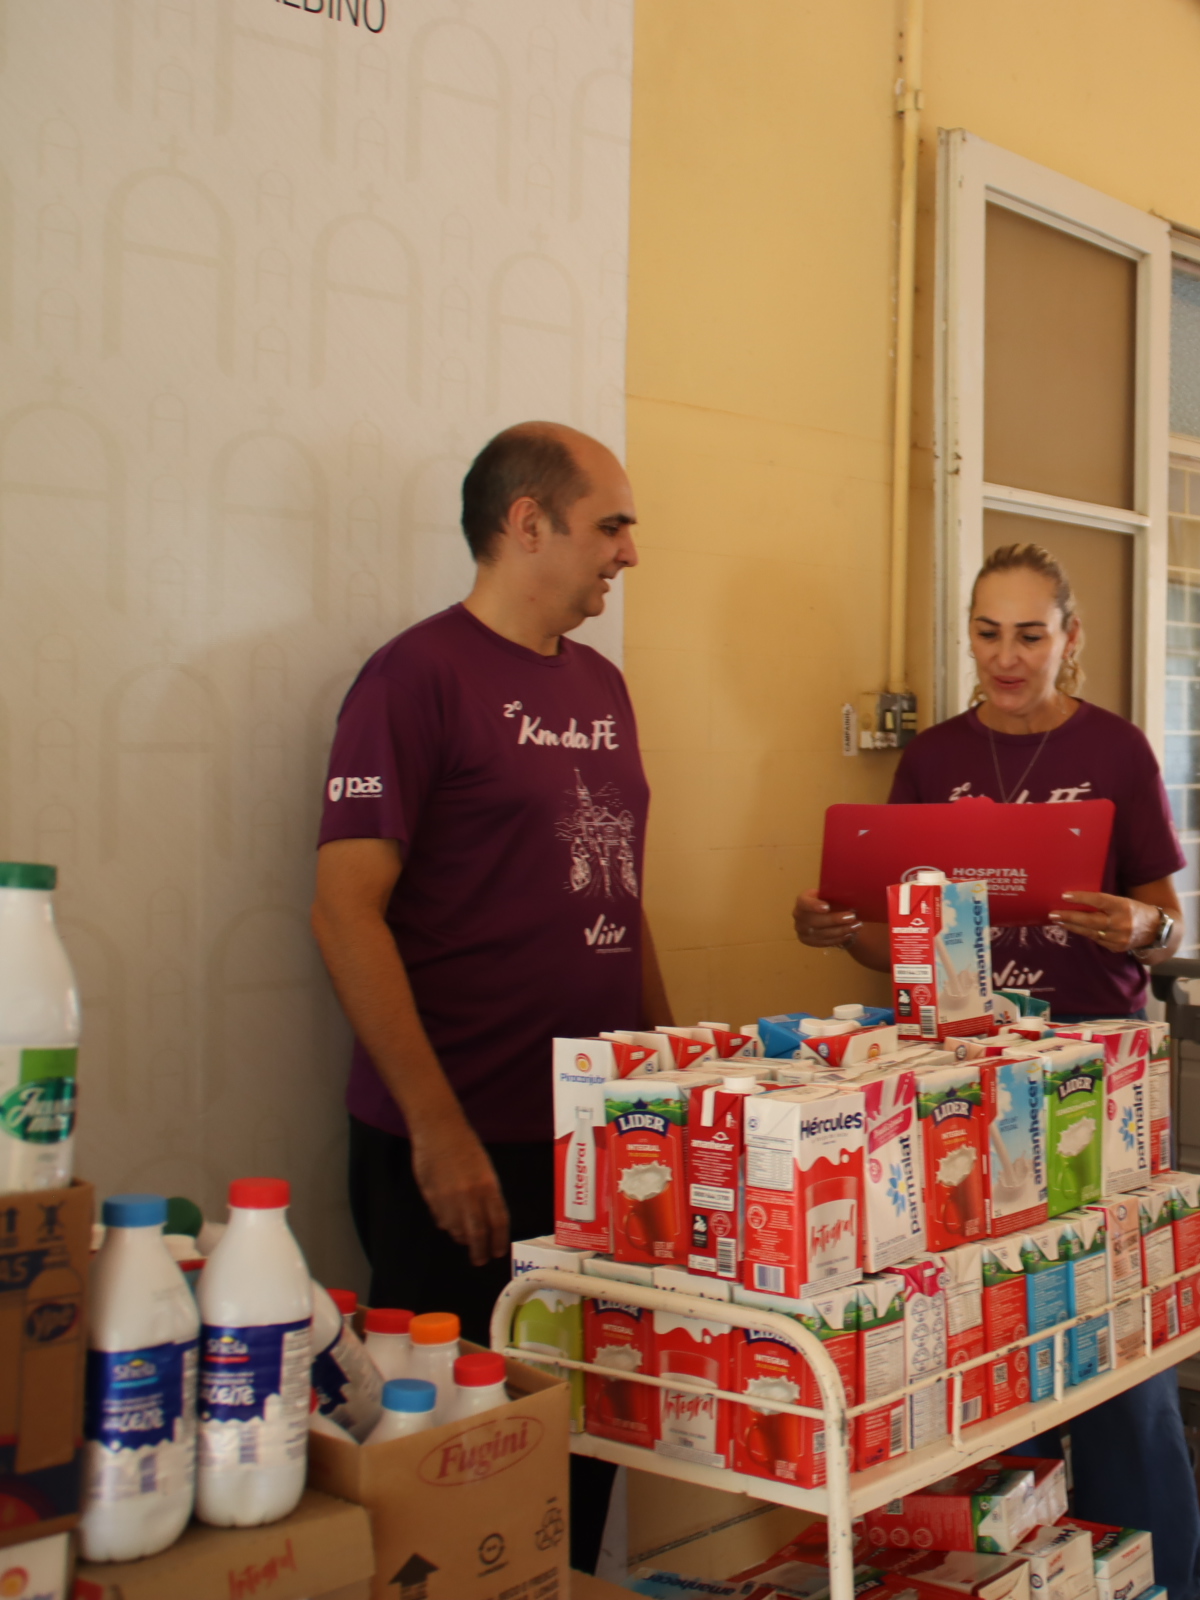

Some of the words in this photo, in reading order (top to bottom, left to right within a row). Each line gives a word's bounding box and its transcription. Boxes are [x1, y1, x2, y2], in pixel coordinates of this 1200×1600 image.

[517, 714, 561, 746] Km
[560, 717, 590, 749] da
[952, 867, 1029, 878] HOSPITAL
[971, 895, 989, 997] amanhecer
[993, 959, 1044, 987] Viiv
[1058, 1076, 1094, 1099] LIDER
[617, 1113, 666, 1133] LIDER
[933, 1100, 971, 1123] LIDER
[1131, 1082, 1148, 1170] parmalat
[800, 1112, 863, 1141] Hércules
[1026, 1076, 1042, 1185] amanhecer
[898, 1134, 922, 1235] parmalat
[753, 1353, 791, 1368] INTEGRAL
[436, 1421, 528, 1480] Fugini
